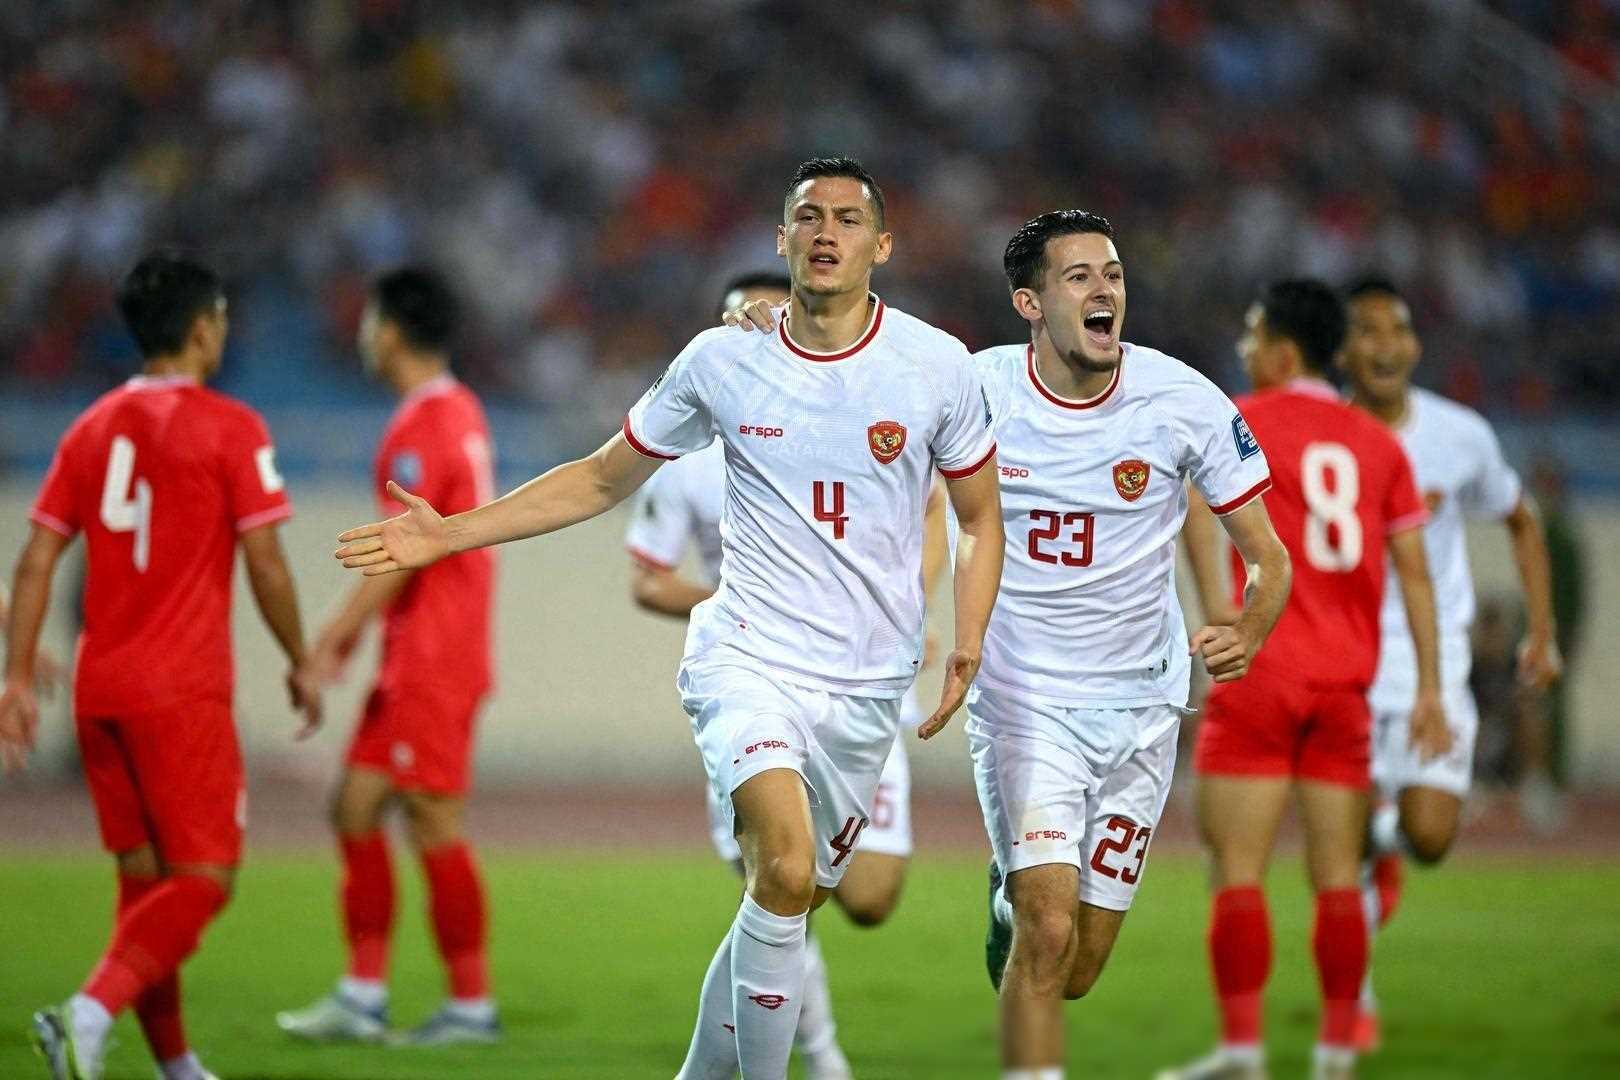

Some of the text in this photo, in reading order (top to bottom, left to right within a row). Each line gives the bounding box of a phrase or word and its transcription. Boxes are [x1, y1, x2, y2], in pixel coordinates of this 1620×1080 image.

[739, 424, 784, 440] erspo
[997, 465, 1029, 479] spo
[101, 435, 153, 573] 4
[812, 480, 850, 540] 4
[1301, 441, 1364, 573] 8
[1027, 508, 1096, 568] 23
[745, 739, 789, 755] erspo
[829, 816, 867, 867] 4
[1024, 829, 1067, 842] erspo
[1089, 815, 1152, 886] 23
